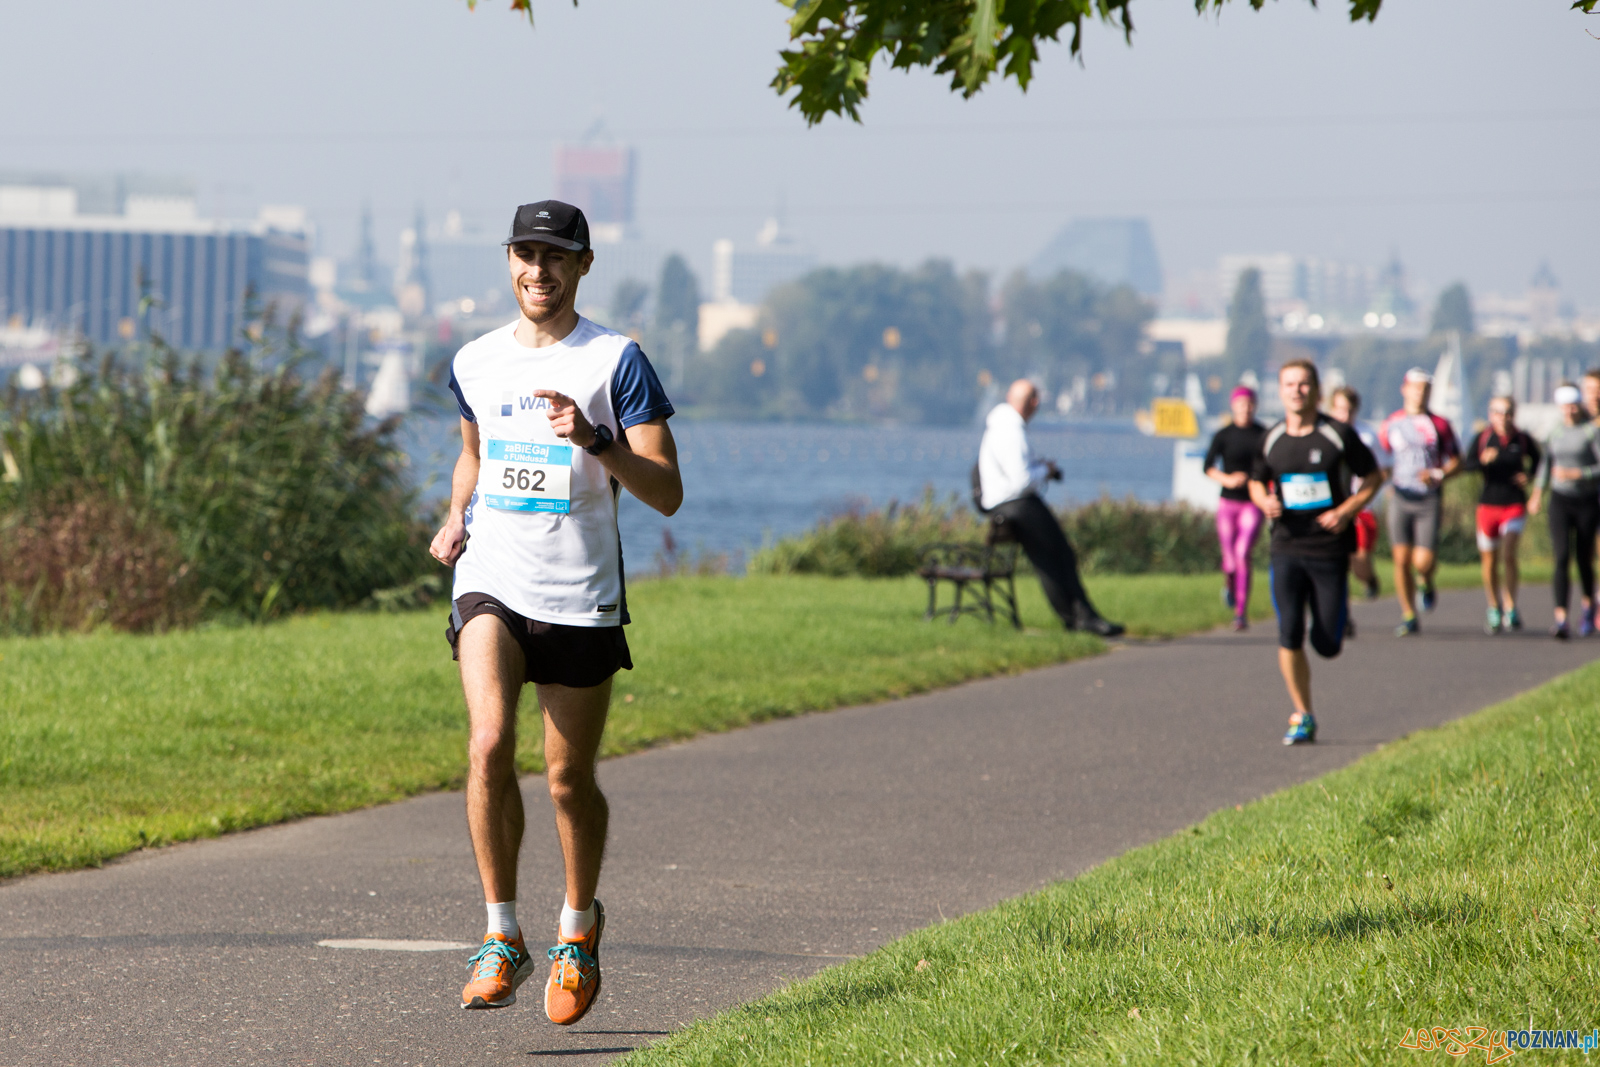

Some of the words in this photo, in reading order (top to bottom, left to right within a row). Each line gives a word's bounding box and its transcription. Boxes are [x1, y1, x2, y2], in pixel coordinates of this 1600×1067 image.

[504, 443, 550, 458] zaBIEGaj
[509, 453, 549, 463] FUNdusze
[502, 467, 546, 492] 562
